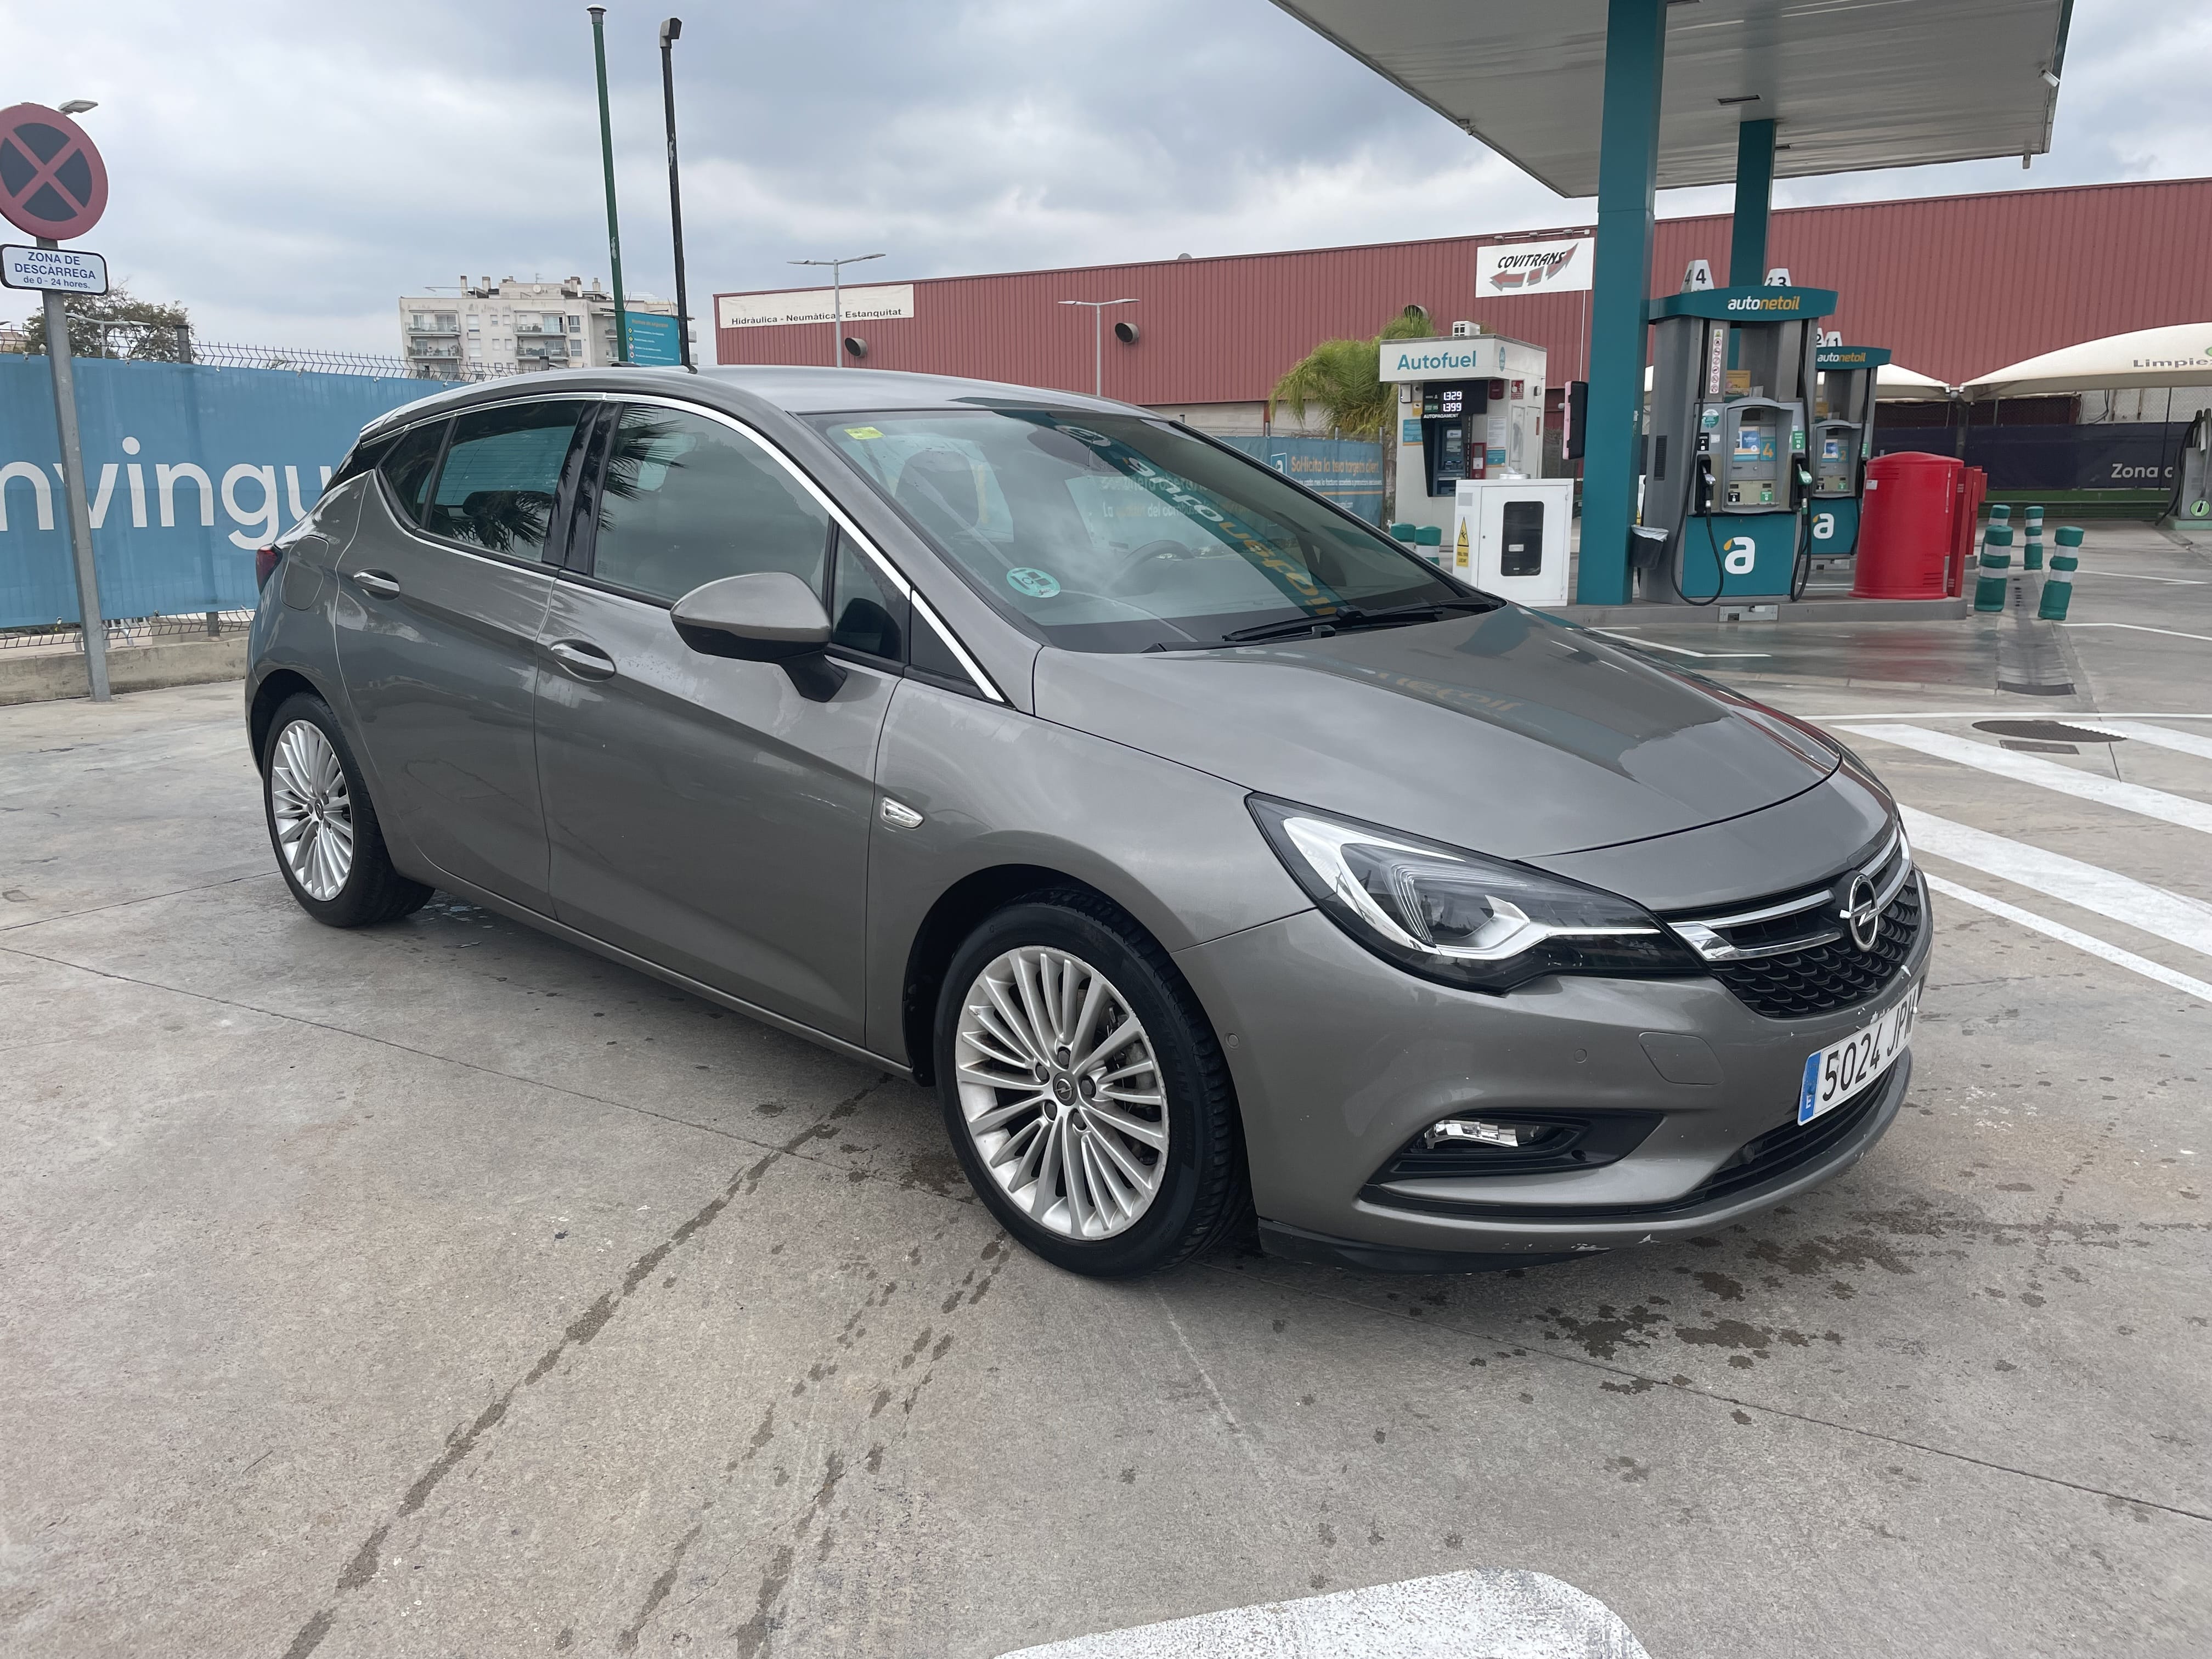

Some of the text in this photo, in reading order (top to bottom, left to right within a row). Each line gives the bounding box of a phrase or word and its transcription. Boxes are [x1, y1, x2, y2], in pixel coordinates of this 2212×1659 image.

[28, 252, 80, 265] ZONA DE
[1498, 251, 1565, 268] COVITRANS
[15, 263, 96, 279] DESCÀRREGA
[1685, 269, 1692, 285] 4
[1695, 269, 1706, 284] 4
[64, 279, 91, 289] hores.
[1728, 296, 1801, 311] autonetoil
[731, 316, 777, 325] Hidràulica
[786, 312, 836, 322] Neumàtica
[845, 308, 902, 318] Estanquitat
[1833, 337, 1838, 347] 1
[1397, 350, 1476, 370] Autofuel
[1817, 352, 1866, 362] autonetoil
[1763, 443, 1774, 458] 4
[2111, 463, 2159, 478] Zona
[1822, 1023, 1883, 1102] 5024
[1805, 1094, 1812, 1109] E
